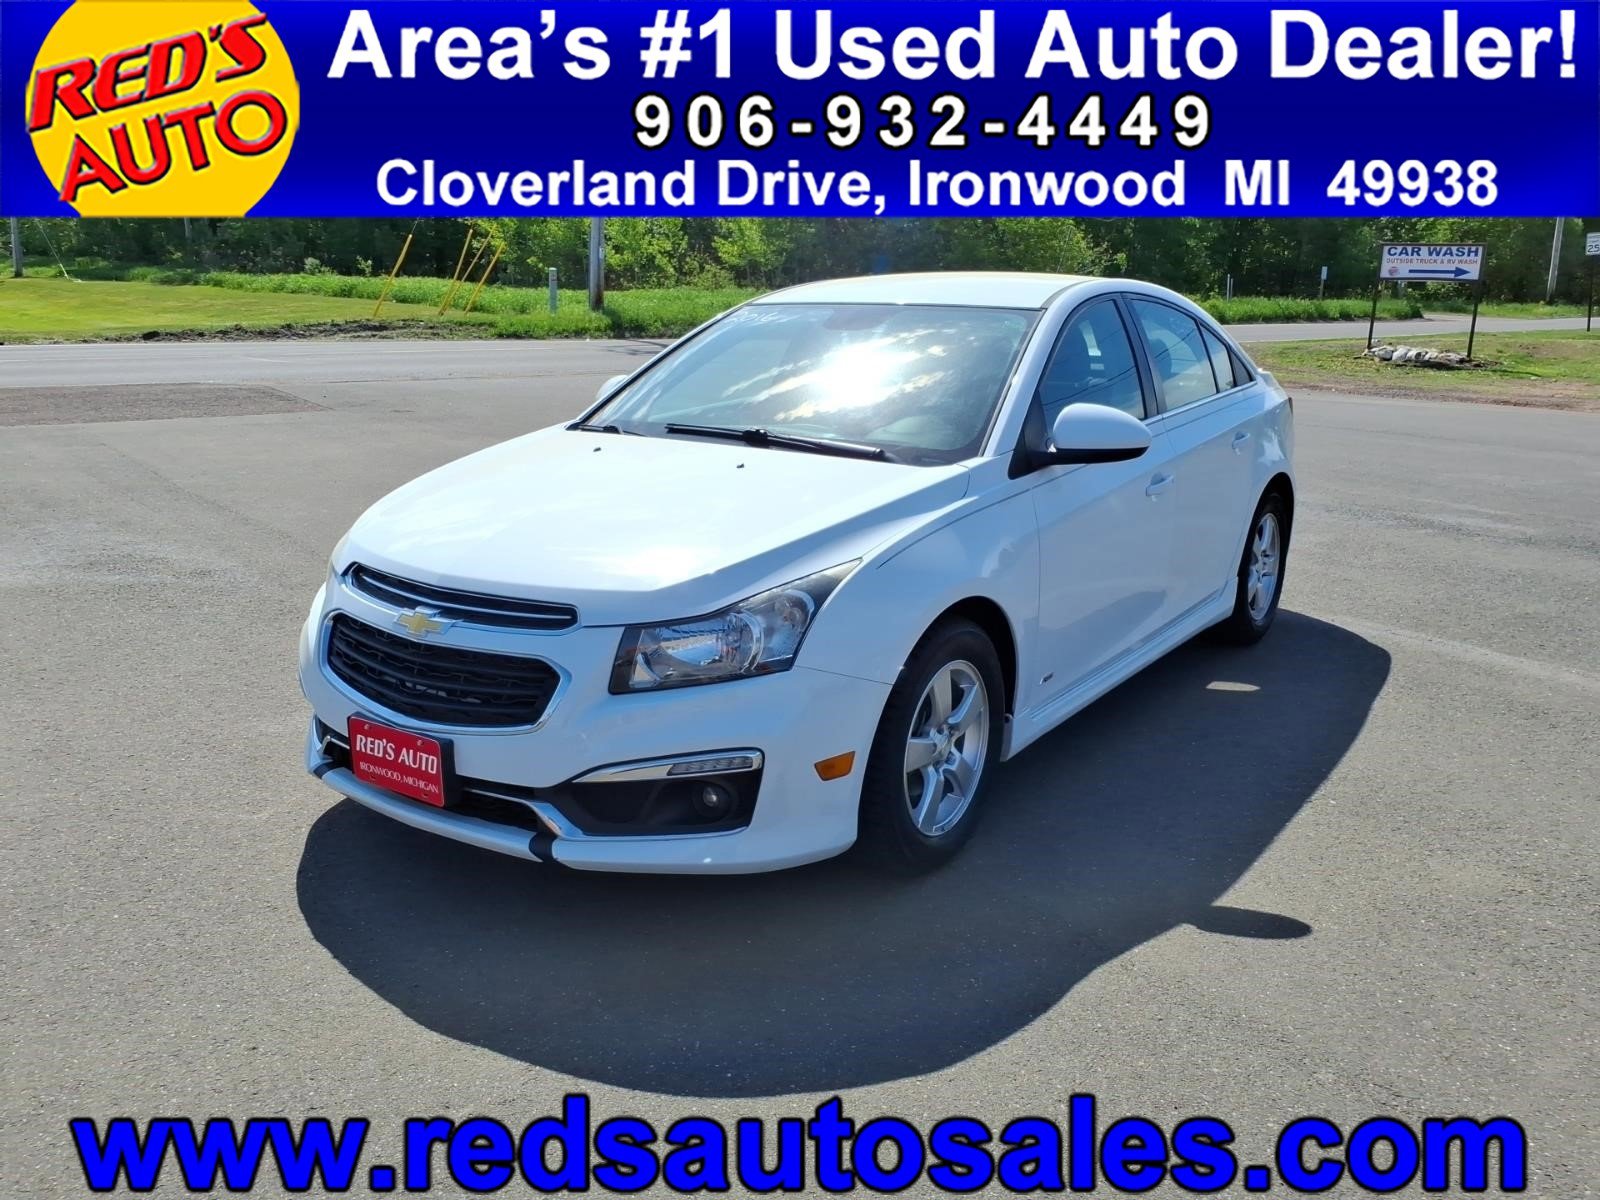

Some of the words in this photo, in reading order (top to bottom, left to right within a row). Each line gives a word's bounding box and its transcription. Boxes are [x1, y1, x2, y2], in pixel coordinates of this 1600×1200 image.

[1387, 246, 1421, 257] CAR
[1428, 246, 1479, 257] WASH
[355, 734, 396, 761] RED'S
[398, 747, 438, 775] AUTO
[359, 761, 402, 783] IRONWOOD,
[402, 775, 440, 794] MICHIGAN
